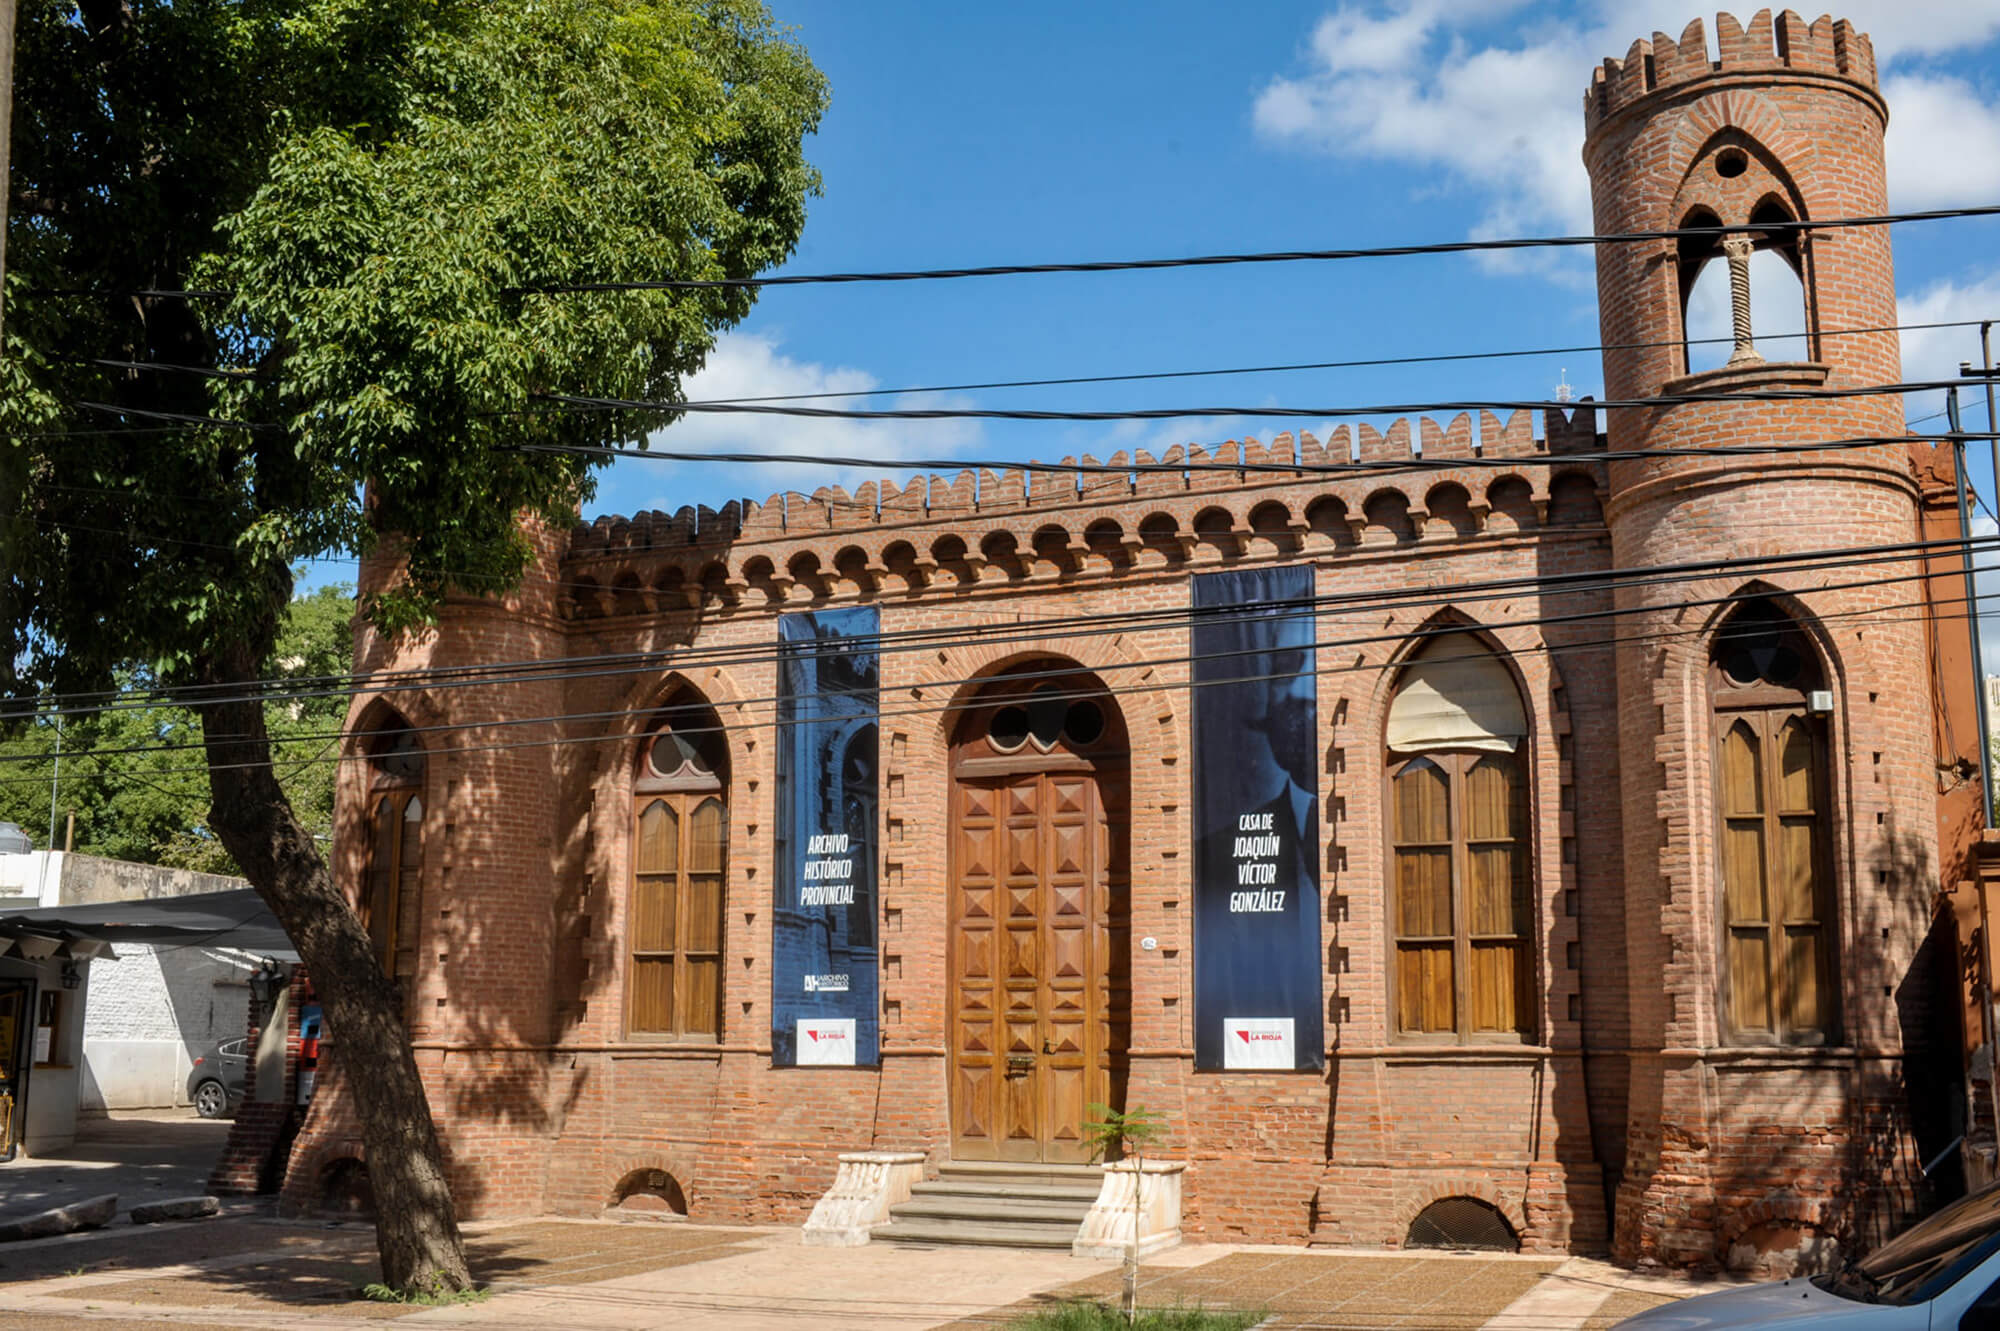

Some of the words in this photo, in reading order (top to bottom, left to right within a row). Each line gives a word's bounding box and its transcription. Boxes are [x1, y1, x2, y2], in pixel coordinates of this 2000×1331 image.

[1239, 814, 1261, 831] CASA
[1261, 813, 1274, 830] DE
[807, 833, 849, 854] ARCHIVO
[1232, 831, 1280, 860] JOAQUÍN
[804, 856, 852, 880] HISTÓRICO
[1238, 860, 1277, 885] VÍCTOR
[800, 885, 855, 906] PROVINCIAL
[1230, 887, 1286, 912] GONZÁLEZ
[1251, 1033, 1260, 1041] LA
[1261, 1033, 1283, 1041] RIOJA
